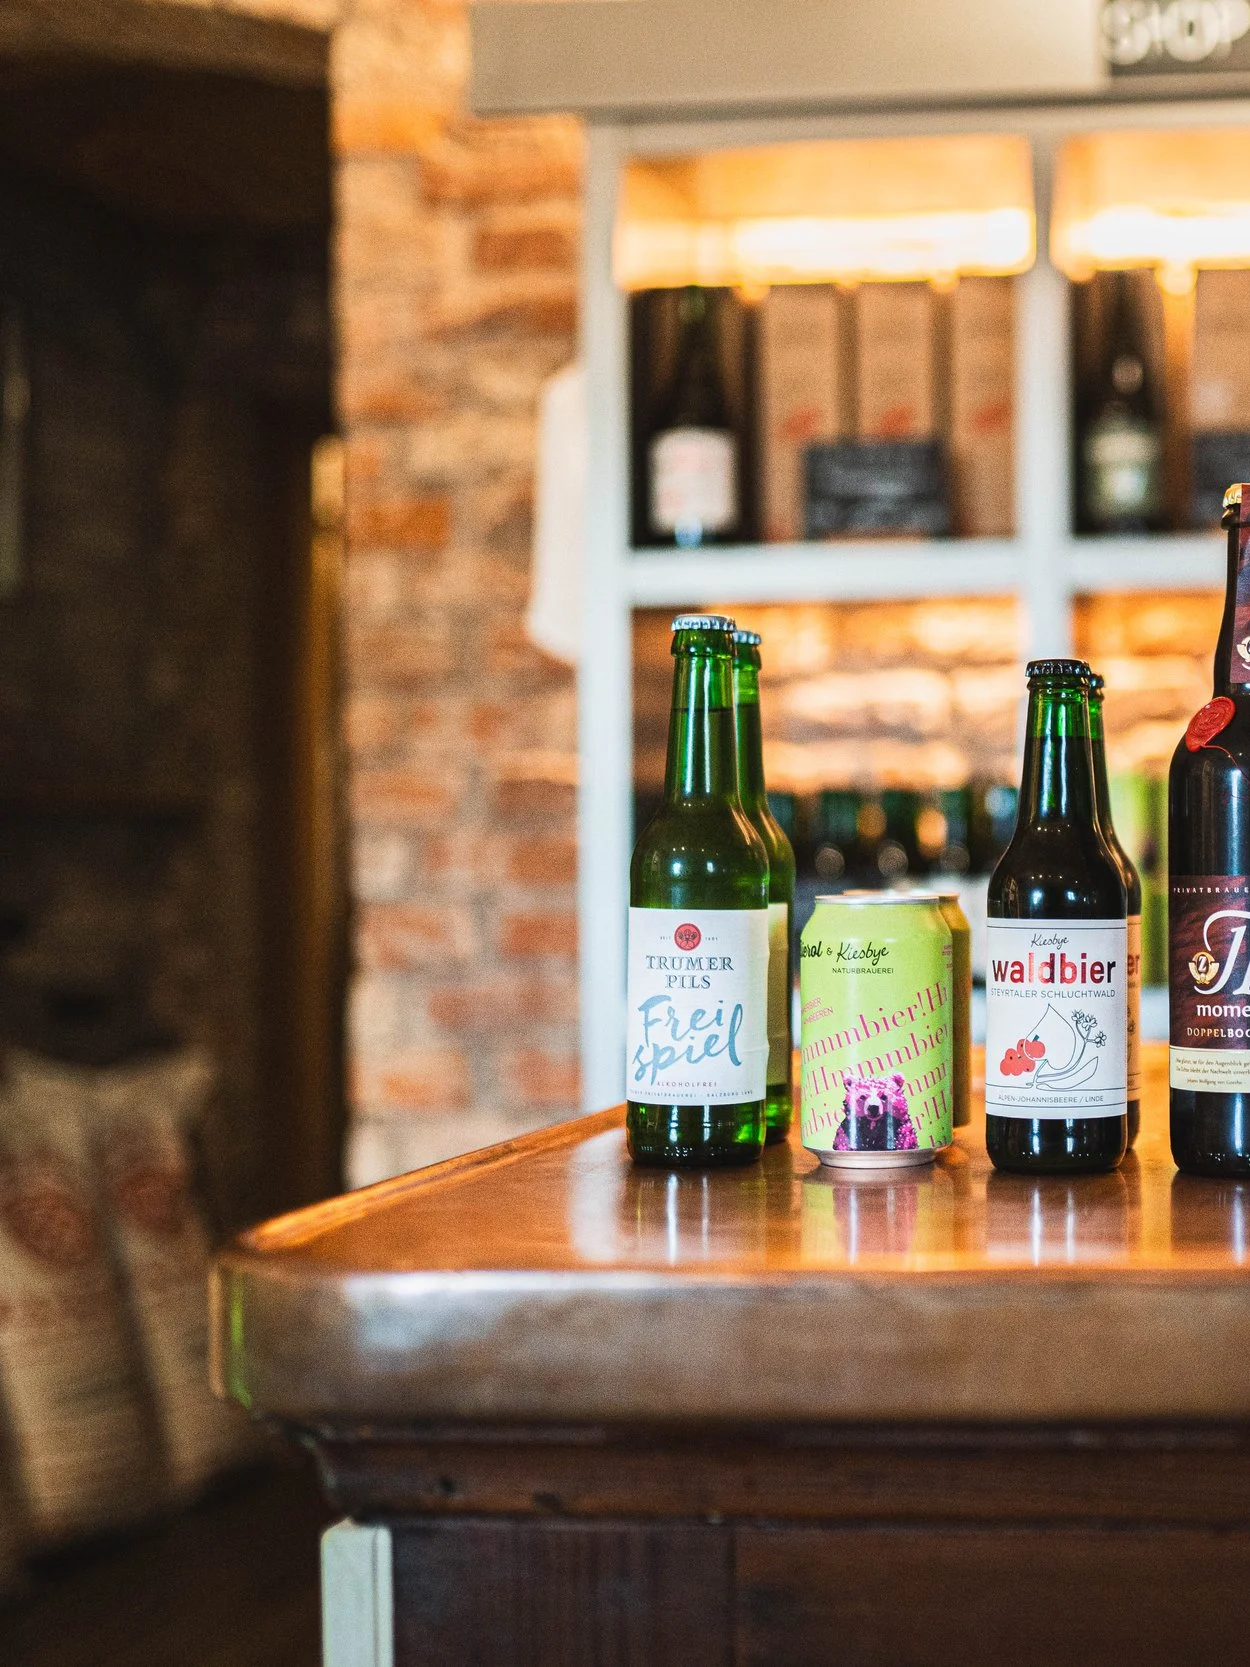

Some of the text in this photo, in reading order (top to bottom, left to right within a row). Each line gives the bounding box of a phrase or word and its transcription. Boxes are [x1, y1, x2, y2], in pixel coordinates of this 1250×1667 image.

[1031, 933, 1069, 950] Kiesbye
[826, 947, 833, 956] &
[836, 941, 889, 966] Kiesbye
[645, 955, 734, 971] TRUMER
[992, 953, 1116, 984] waldbier
[664, 974, 711, 989] PILS
[991, 988, 1116, 999] STEYRTALER SCHLUCHTWALD
[637, 994, 724, 1047] Frei
[632, 1003, 743, 1086] spiel
[998, 1094, 1077, 1104] ALPEN-JOHANNISBEERE
[1085, 1095, 1104, 1103] LINDE
